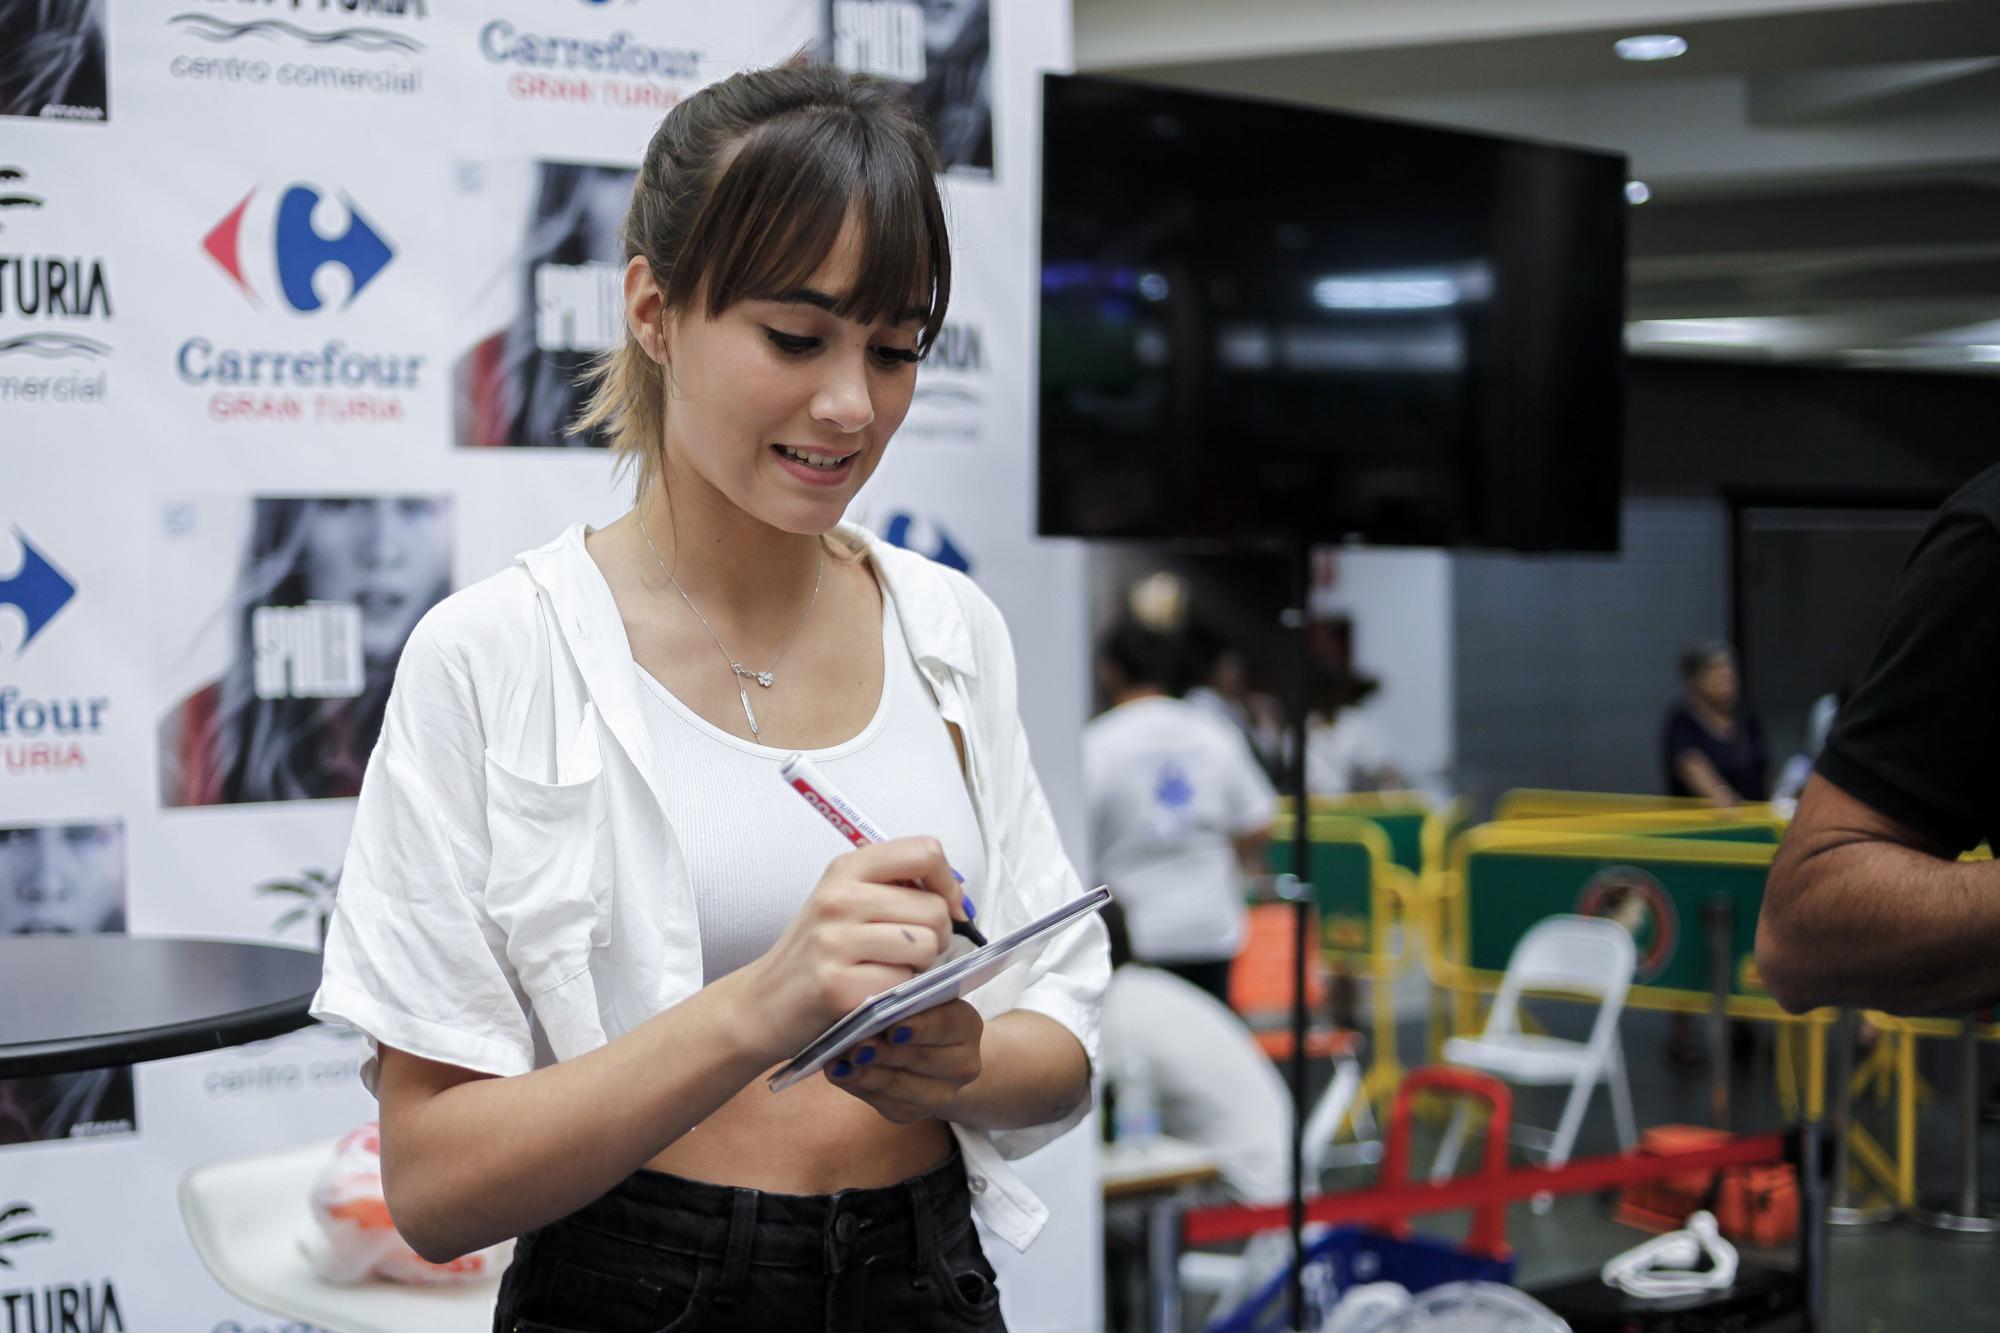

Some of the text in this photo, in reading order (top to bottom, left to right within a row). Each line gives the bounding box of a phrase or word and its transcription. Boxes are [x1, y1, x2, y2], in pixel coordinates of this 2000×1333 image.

[479, 19, 706, 78] Carrefour
[170, 55, 421, 93] centro comercial
[508, 71, 592, 102] GRAN
[177, 337, 424, 390] Carrefour
[208, 392, 404, 424] GRAN TURIA
[204, 1064, 299, 1098] centro
[3, 1282, 124, 1333] TURIA
